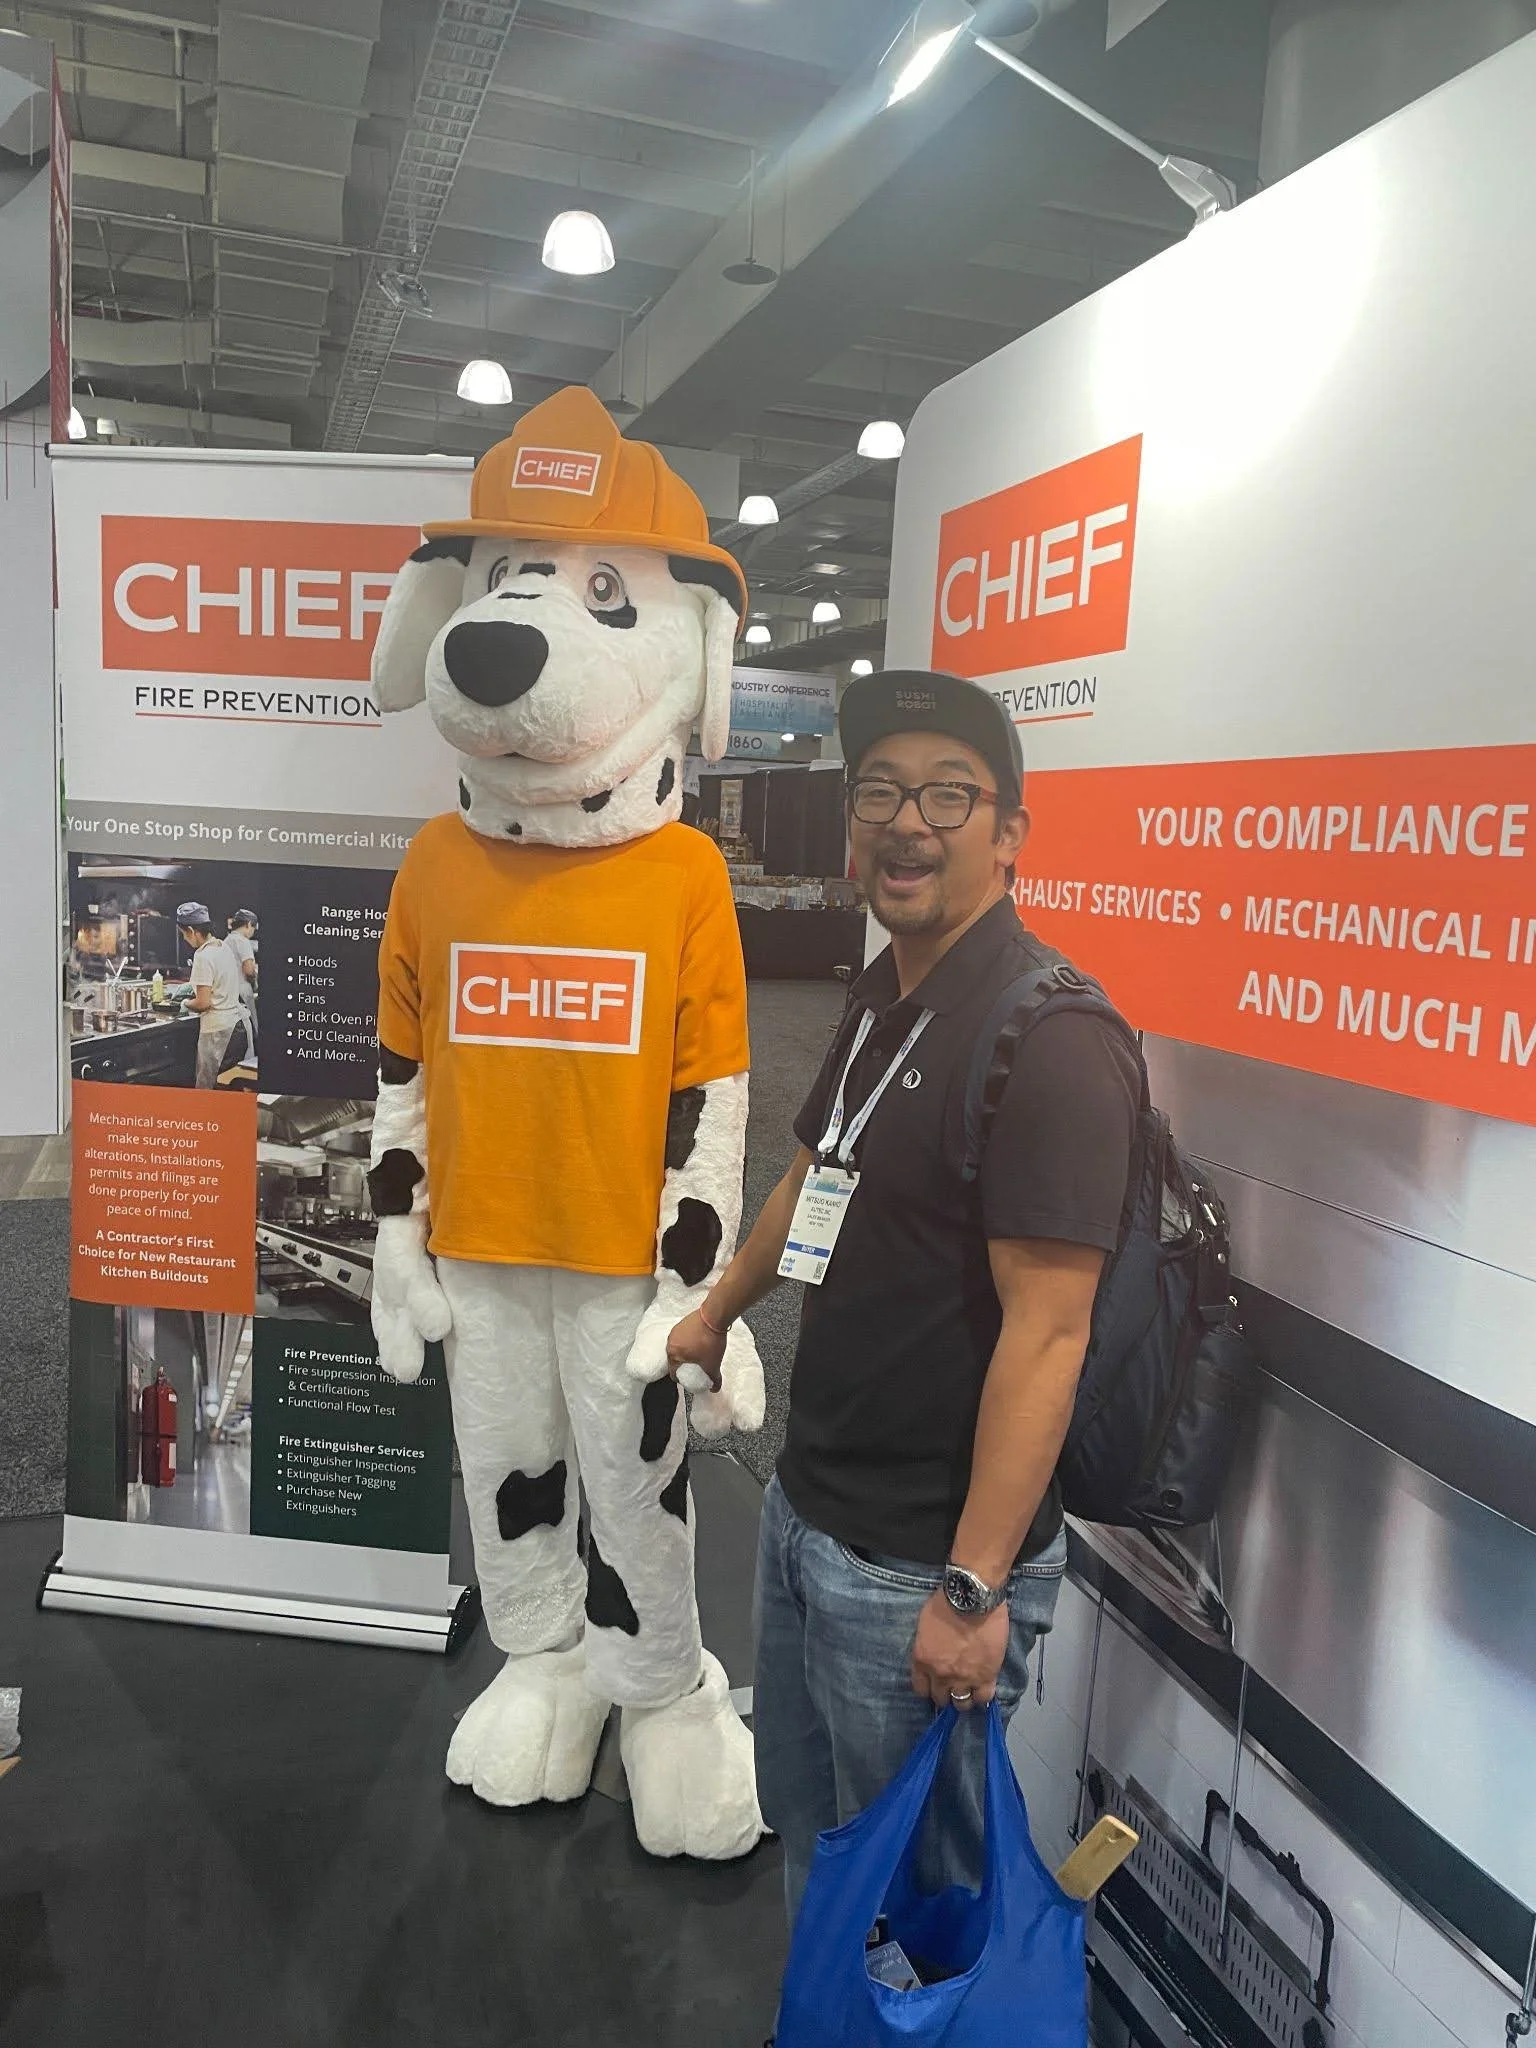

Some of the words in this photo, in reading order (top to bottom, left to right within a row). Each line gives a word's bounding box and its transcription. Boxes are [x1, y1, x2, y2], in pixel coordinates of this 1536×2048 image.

[520, 459, 592, 481] CHIEF
[939, 503, 1128, 637] CHIEF
[113, 562, 400, 641] CHIEF
[771, 684, 831, 697] CONFERENCE
[895, 690, 936, 700] SUSHI
[135, 686, 194, 709] FIRE
[204, 688, 382, 717] PREVENTION
[896, 700, 937, 709] ROBOT
[65, 816, 100, 834] Your
[104, 818, 140, 835] One
[145, 819, 185, 840] Stop
[188, 822, 233, 843] Shop
[237, 825, 263, 842] for
[267, 827, 375, 849] Commercial
[1137, 807, 1222, 848] YOUR
[1233, 803, 1529, 857] COMPLIANCE
[321, 906, 361, 921] Range
[1090, 883, 1202, 926] SERVICES
[1244, 894, 1491, 961] MECHANICAL
[303, 923, 359, 940] Cleaning
[298, 955, 337, 968] Hoods
[298, 974, 335, 987] Filters
[298, 992, 326, 1005] Fans
[461, 975, 627, 1021] CHIEF
[298, 1010, 328, 1024] Brick
[331, 1012, 362, 1025] Oven
[1238, 970, 1323, 1024] AND
[1336, 985, 1482, 1058] MUCH
[298, 1029, 323, 1041] PCU
[326, 1031, 378, 1048] Cleaning
[297, 1047, 321, 1060] And
[324, 1050, 366, 1062] More...
[89, 1112, 154, 1129] Mechanical
[156, 1117, 204, 1131] services
[207, 1120, 219, 1132] to
[108, 1132, 139, 1147] make
[142, 1135, 169, 1147] sure
[171, 1138, 199, 1151] your
[84, 1148, 147, 1165] alterations,
[150, 1152, 225, 1170] Installations,
[89, 1166, 134, 1182] permits
[136, 1169, 158, 1182] and
[160, 1170, 196, 1187] filings
[199, 1175, 218, 1186] are
[88, 1184, 117, 1197] done
[119, 1186, 170, 1205] properly
[172, 1188, 189, 1201] for
[191, 1193, 220, 1207] your
[106, 1205, 142, 1217] peace
[144, 1204, 157, 1216] of
[159, 1206, 193, 1220] mind.
[96, 1229, 104, 1241] A
[185, 1234, 214, 1249] First
[78, 1245, 114, 1259] Choice
[117, 1247, 136, 1259] for
[139, 1250, 166, 1264] New
[168, 1252, 236, 1269] Restaurant
[100, 1265, 148, 1281] Kitchen
[150, 1268, 209, 1285] Buildouts
[284, 1348, 306, 1359] Fire
[309, 1350, 372, 1365] Prevention
[288, 1364, 309, 1376] Fire
[311, 1367, 377, 1382] suppression
[288, 1380, 297, 1391] &
[299, 1381, 370, 1397] Certifications
[288, 1396, 344, 1412] Functional
[346, 1402, 371, 1414] Flow
[374, 1404, 397, 1416] Test
[279, 1435, 301, 1447] Fire
[303, 1437, 375, 1454] Extinguisher
[377, 1444, 425, 1459] Services
[287, 1452, 352, 1468] Extinguisher
[355, 1456, 417, 1475] Inspections
[287, 1468, 352, 1484] Extinguisher
[355, 1473, 396, 1491] Tagging
[286, 1484, 335, 1500] Purchase
[338, 1489, 362, 1501] New
[286, 1500, 357, 1517] Extinguishers
